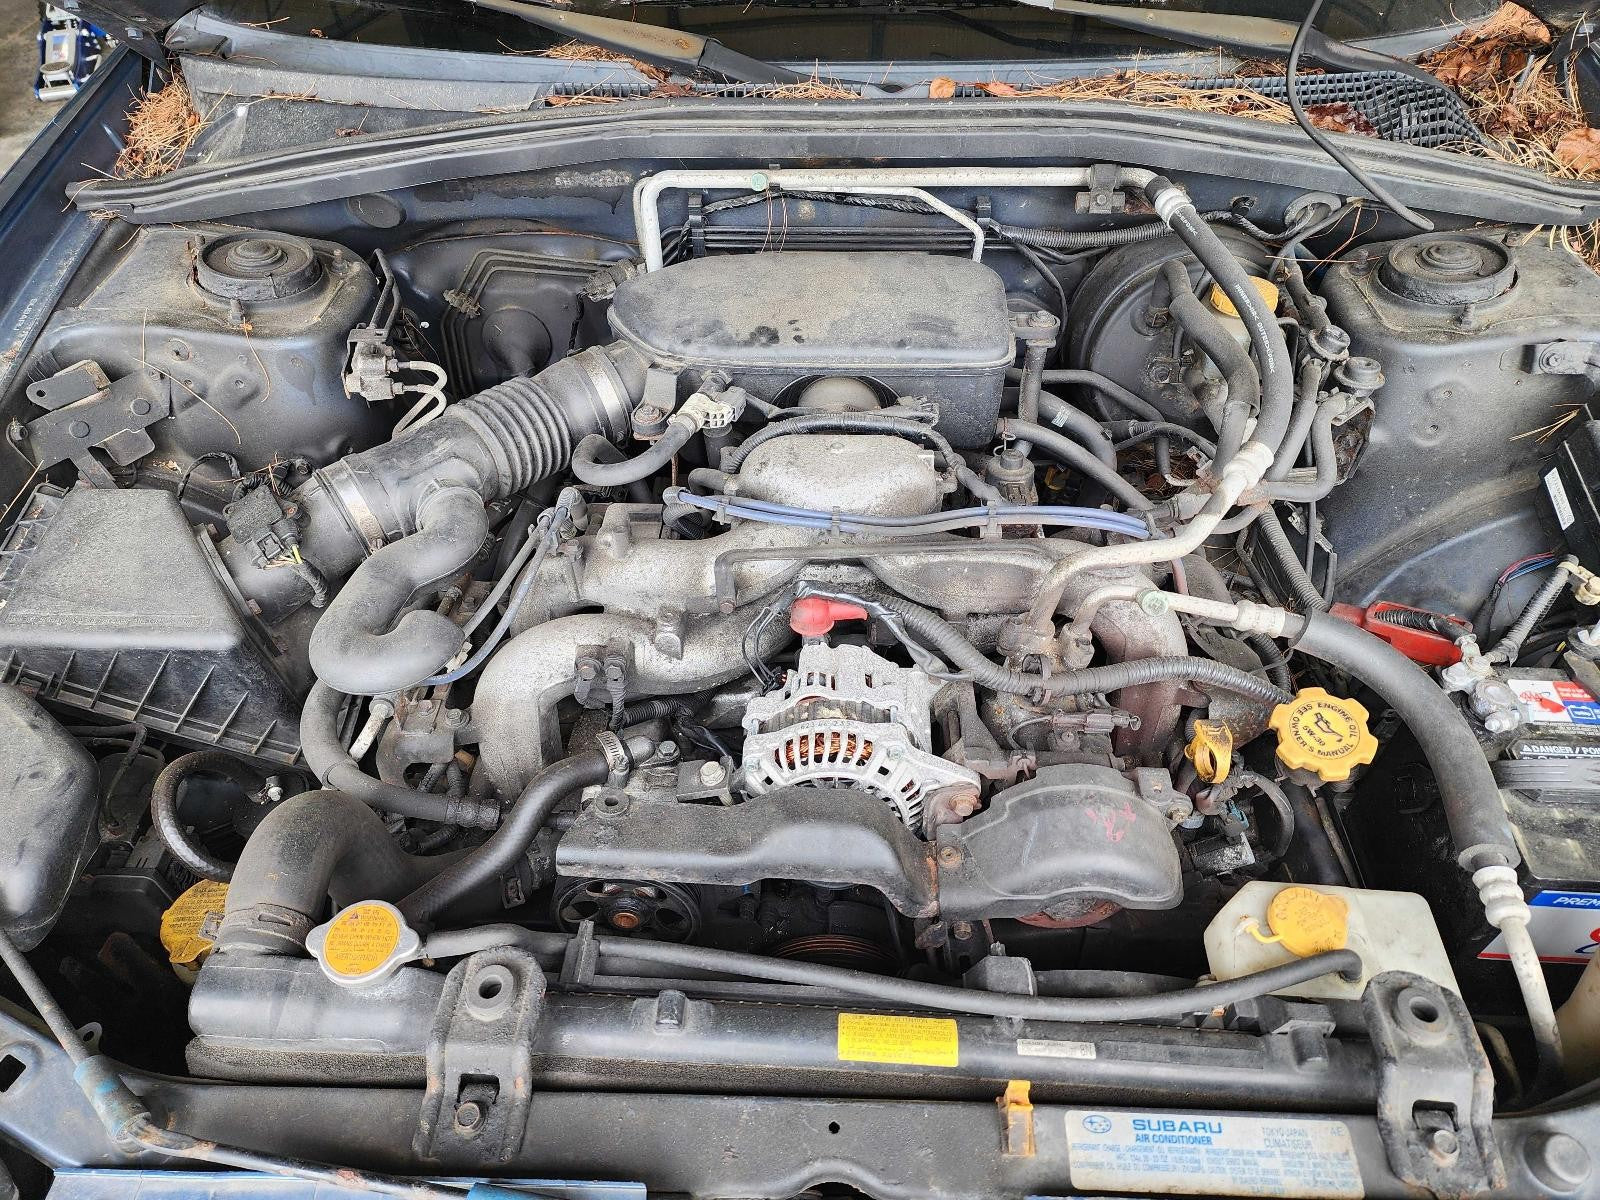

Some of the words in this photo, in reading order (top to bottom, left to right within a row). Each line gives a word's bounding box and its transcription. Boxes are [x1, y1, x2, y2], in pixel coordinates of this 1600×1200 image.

[1317, 702, 1353, 722] ENGINE
[1348, 724, 1358, 739] OIL
[1296, 703, 1313, 716] SEE
[1316, 743, 1354, 757] MANUAL
[1302, 725, 1326, 747] 5W-30
[1532, 745, 1574, 754] DANGER
[1552, 896, 1600, 907] PREM
[1132, 1119, 1223, 1134] SUBARU
[1135, 1134, 1149, 1143] AIR
[1152, 1135, 1213, 1145] CONDITIONER
